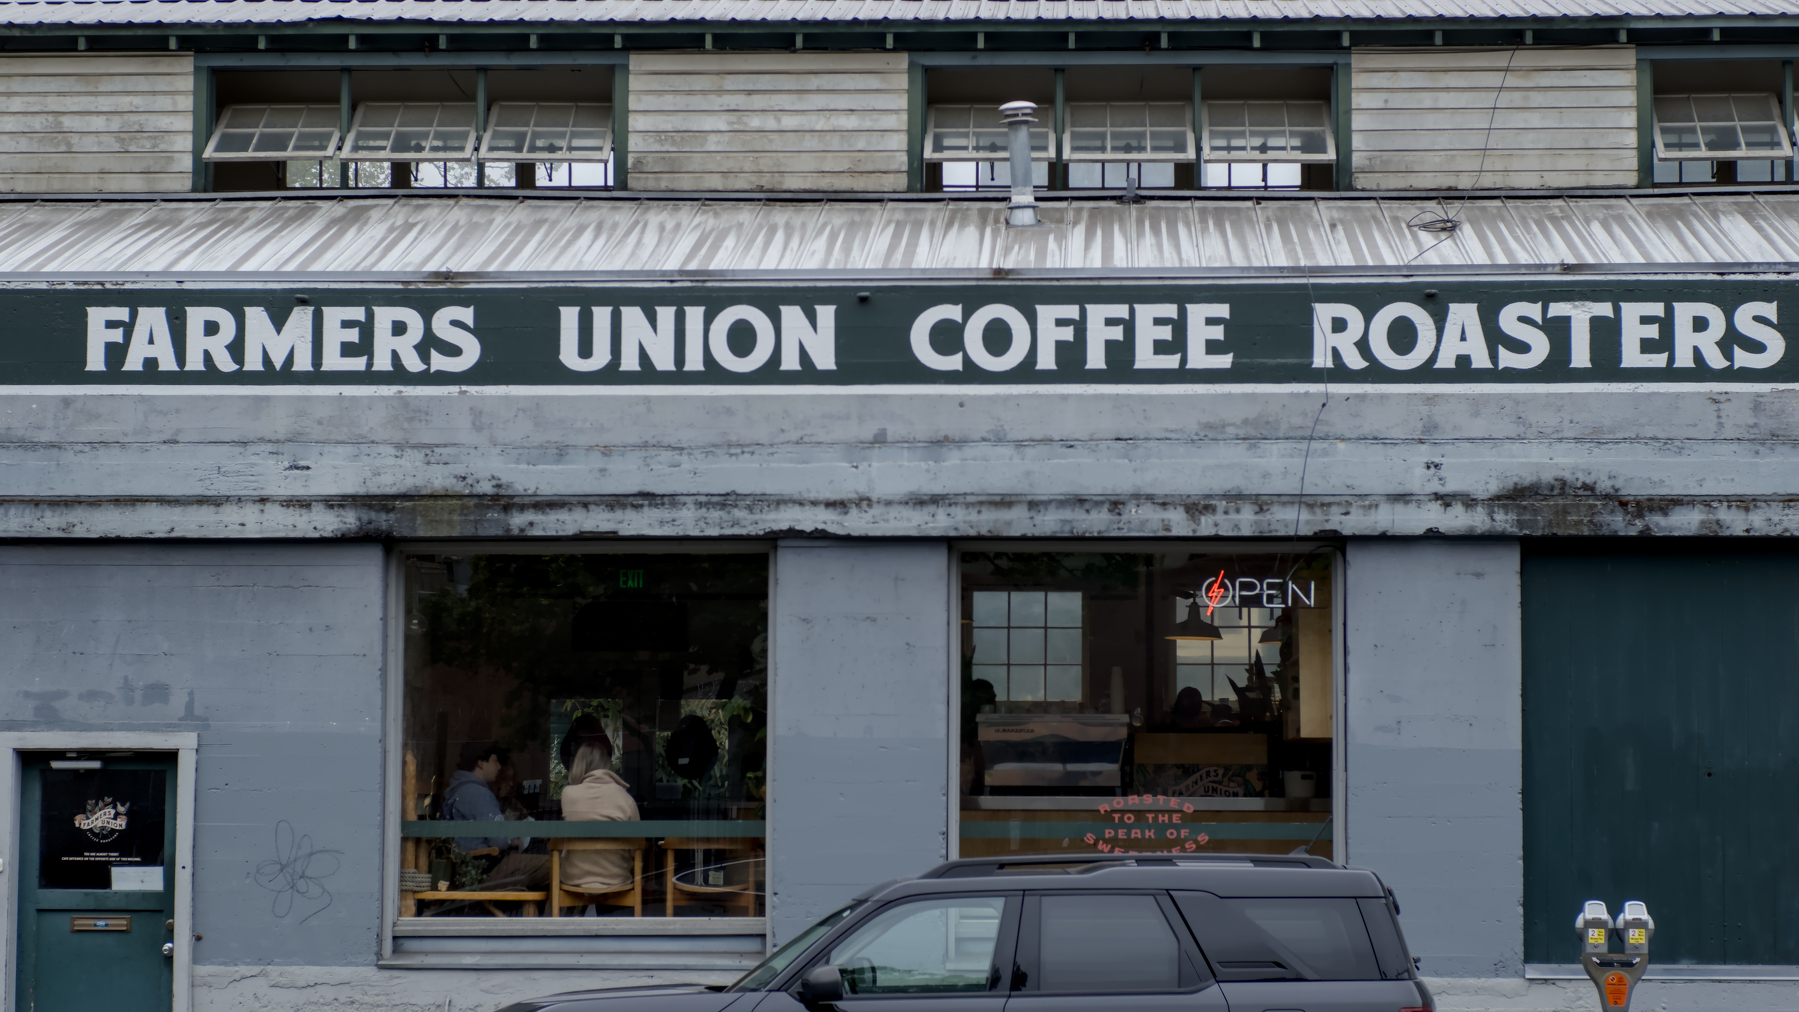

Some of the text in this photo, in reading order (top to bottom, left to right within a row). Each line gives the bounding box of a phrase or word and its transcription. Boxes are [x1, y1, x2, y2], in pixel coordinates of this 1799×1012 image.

[85, 301, 1786, 372] FARMERS UNION COFFEE ROASTERS
[619, 569, 645, 588] EXIT
[1202, 577, 1315, 608] OPEN
[1171, 769, 1220, 797] FARMERS
[1203, 785, 1240, 798] UNION
[1098, 794, 1195, 814] ROASTED
[82, 810, 112, 827] FARMERS
[101, 820, 123, 829] UNION
[1112, 814, 1182, 823] TO THE
[1105, 829, 1190, 839] PEAK OF
[1084, 833, 1210, 855] SWEESS
